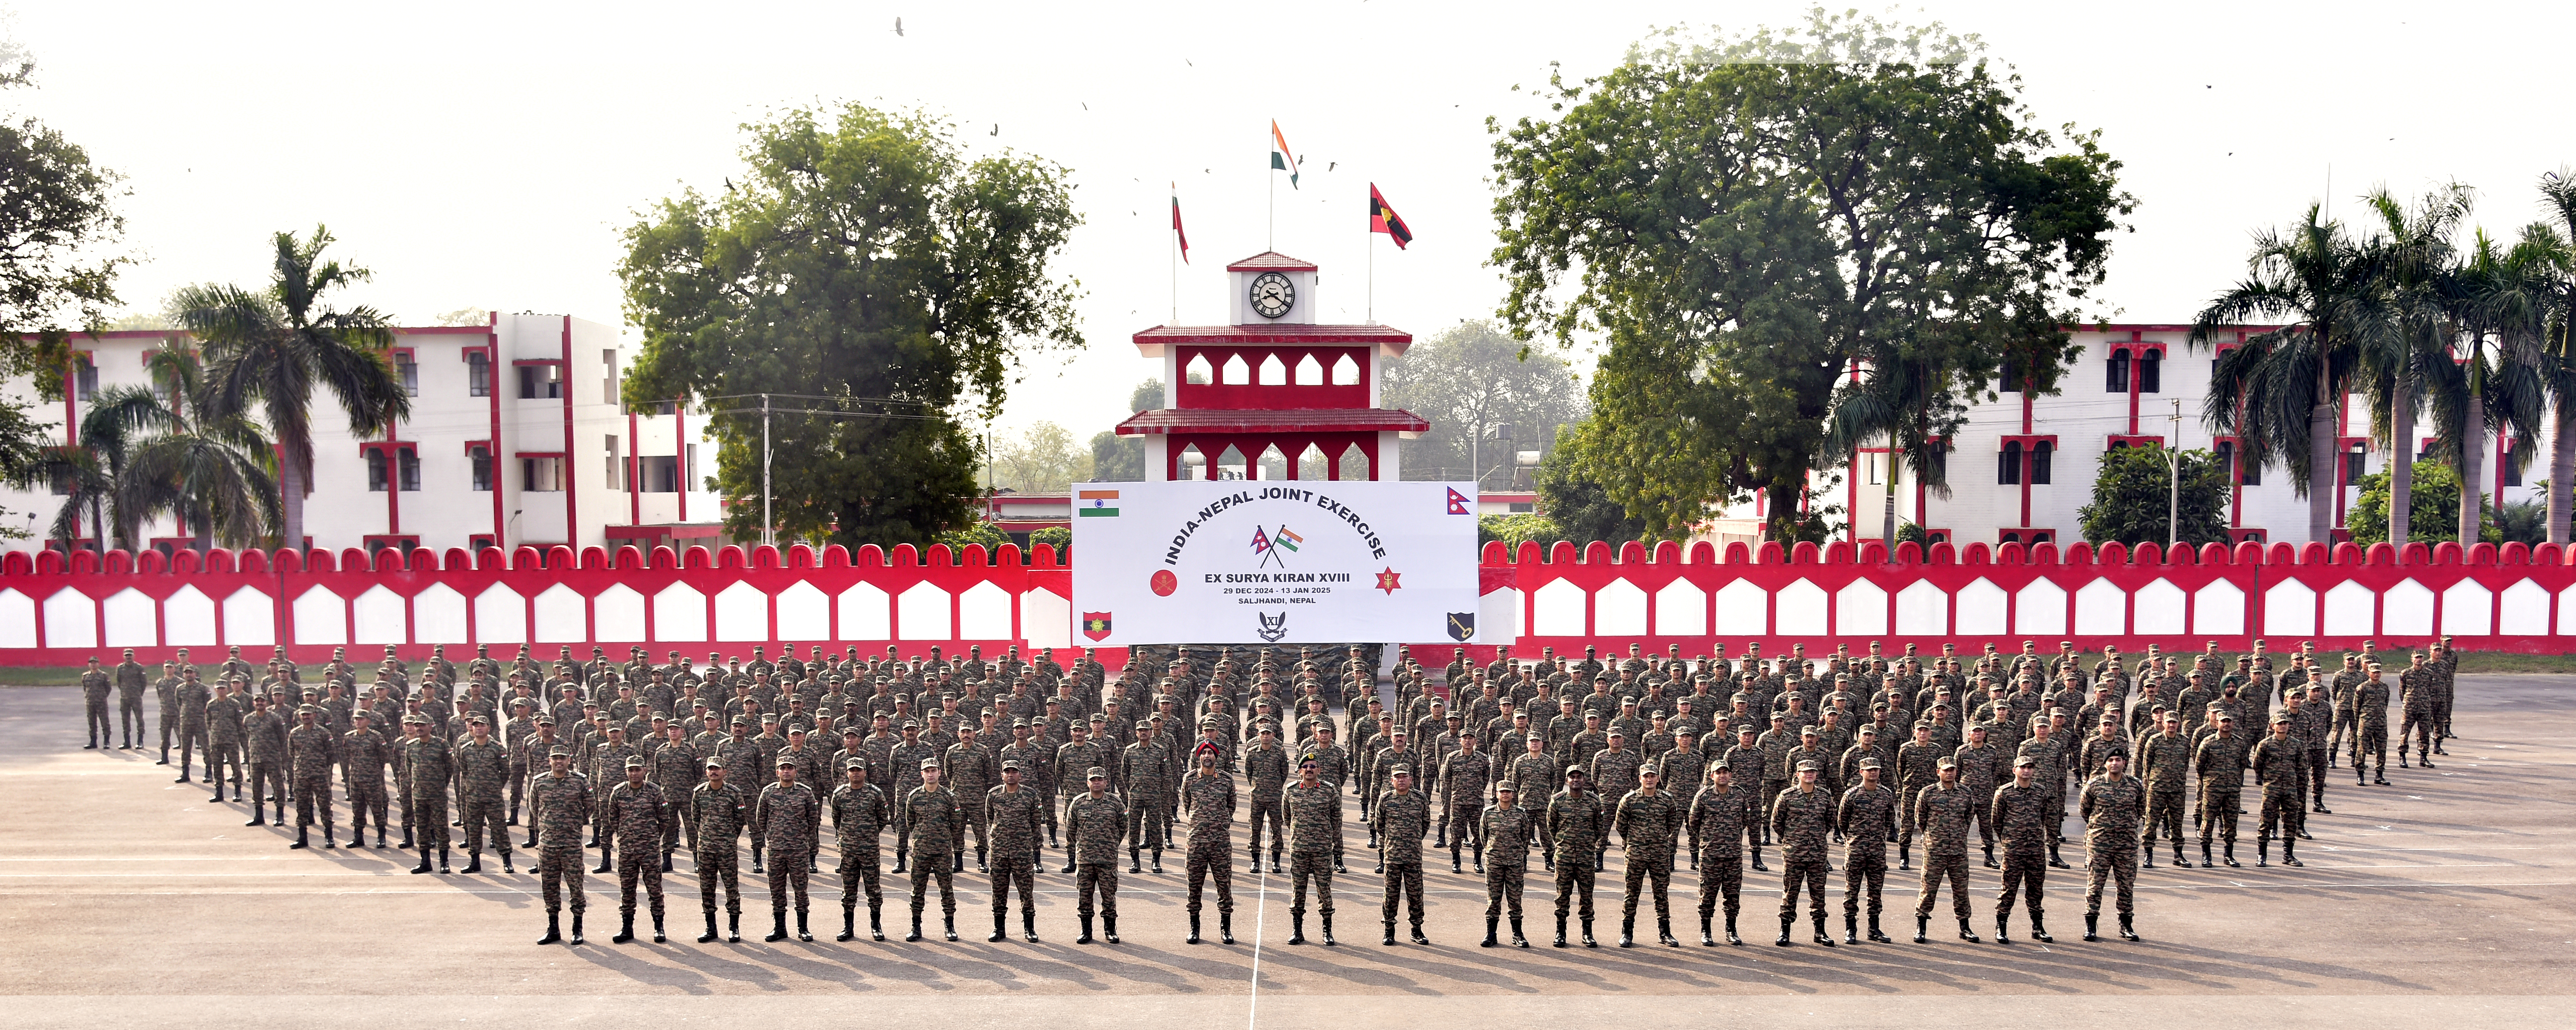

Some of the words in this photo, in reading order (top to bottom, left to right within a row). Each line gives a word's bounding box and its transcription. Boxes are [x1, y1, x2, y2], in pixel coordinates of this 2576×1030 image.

[1165, 491, 1254, 565] INDIA-NEPAL
[1259, 487, 1313, 503] JOINT
[1317, 495, 1386, 560] EXERCISE
[1205, 574, 1222, 583] EX
[1226, 574, 1269, 583] SURYA
[1274, 574, 1314, 582] KIRAN
[1319, 573, 1350, 582] XVIII
[1267, 617, 1278, 625] XI
